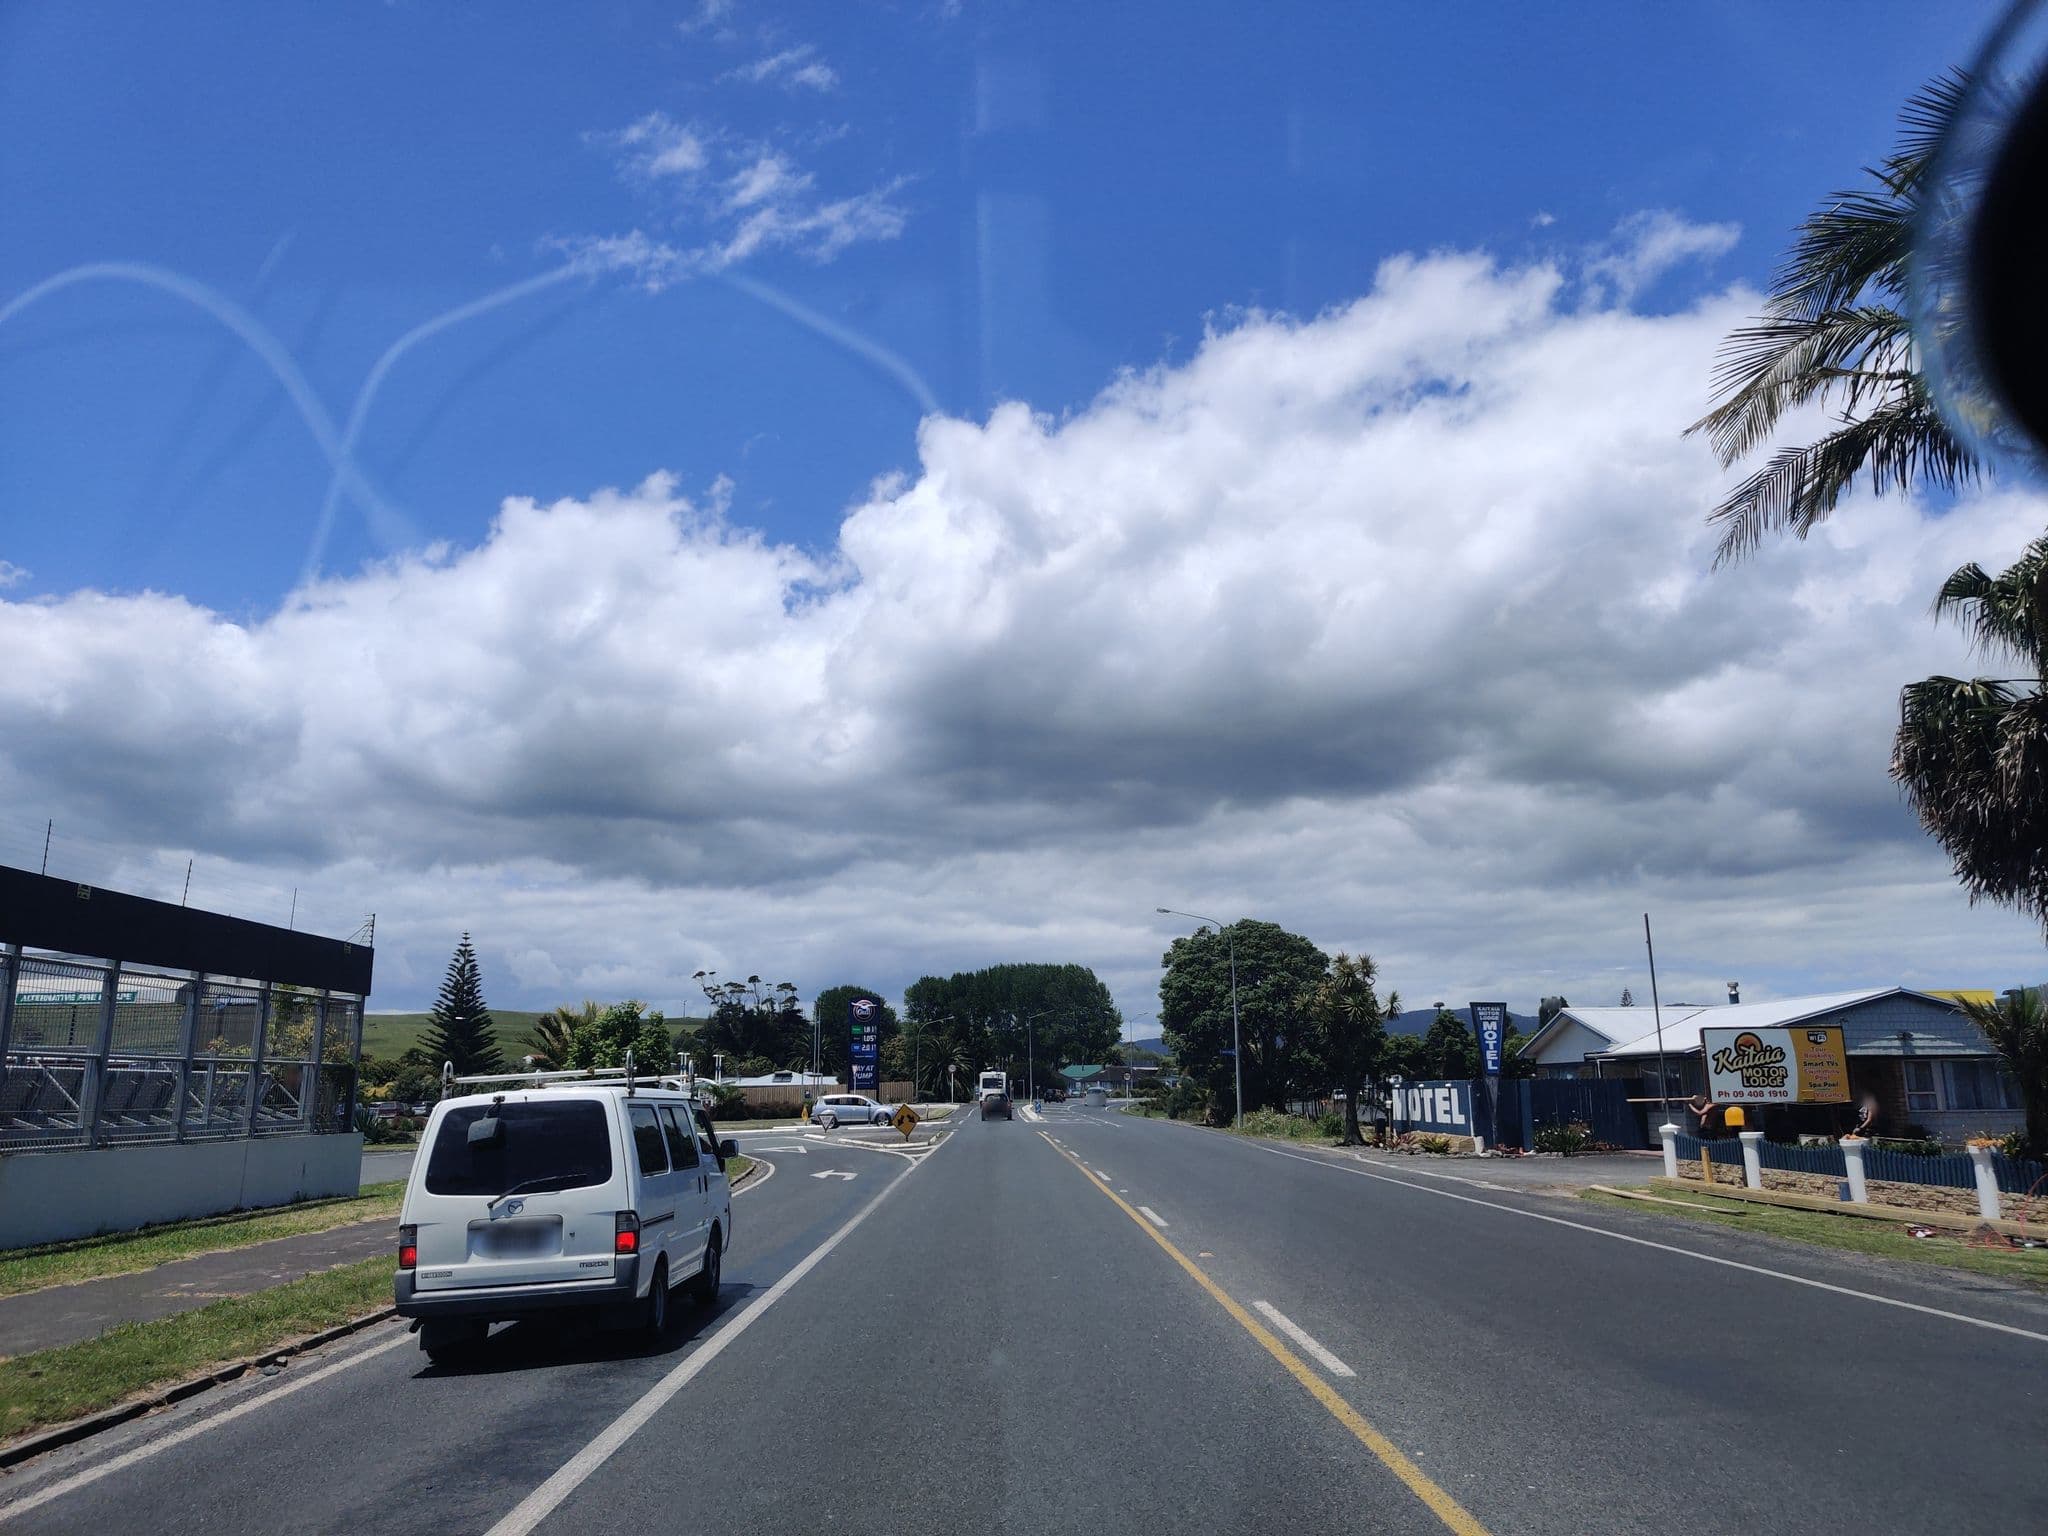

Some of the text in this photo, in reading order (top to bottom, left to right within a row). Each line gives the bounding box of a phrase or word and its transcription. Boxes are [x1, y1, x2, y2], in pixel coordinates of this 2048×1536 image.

[20, 994, 76, 1002] ALTERNATIVE
[1482, 1021, 1498, 1070] MOTEL
[1713, 1046, 1784, 1073] Kaitaia
[1742, 1067, 1787, 1077] MOTOR
[1743, 1076, 1785, 1086] LODGE
[1717, 1090, 1789, 1098] Ph 09 408 1910
[1391, 1087, 1466, 1125] MOTEL
[579, 1260, 609, 1268] mazda
